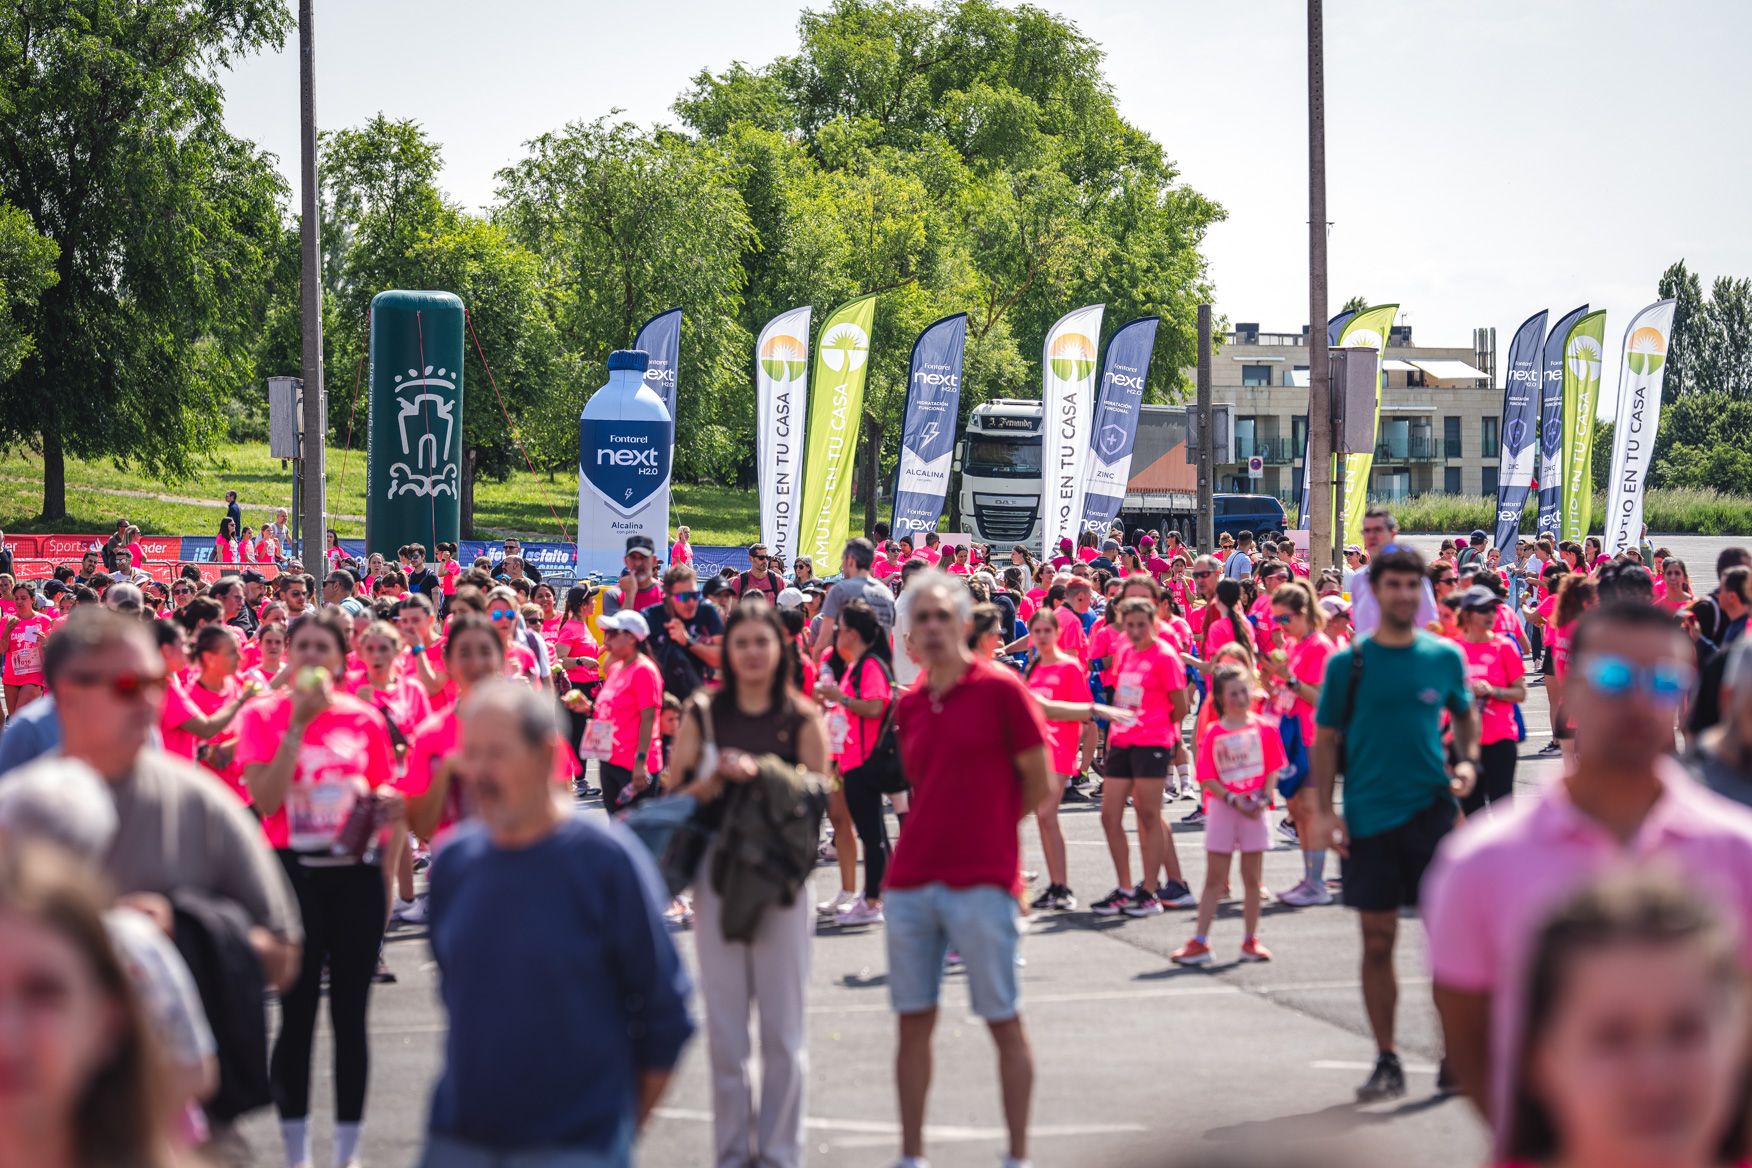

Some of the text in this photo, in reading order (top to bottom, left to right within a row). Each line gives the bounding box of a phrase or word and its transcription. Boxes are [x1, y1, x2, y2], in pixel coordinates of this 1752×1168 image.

[914, 372, 958, 387] next
[1104, 371, 1144, 390] next
[1508, 369, 1538, 381] next
[1543, 369, 1563, 381] ne
[1061, 392, 1077, 440] CASA
[610, 434, 648, 444] Fontarel
[597, 447, 659, 466] next
[1061, 446, 1075, 470] TU
[638, 467, 659, 475] H2.0
[905, 468, 945, 479] ALCALINA
[1570, 391, 1590, 541] UTIO EN TU CASA
[1616, 386, 1646, 552] MUTIO EN TU CASA
[775, 392, 790, 560] MUTIO EN TU CASA
[815, 383, 848, 568] AMUTIO EN TU CASA
[1096, 470, 1115, 480] ZINC
[1060, 476, 1074, 499] EN
[1497, 509, 1522, 522] ex
[611, 521, 644, 530] Alcalina
[896, 516, 937, 532] next
[49, 539, 88, 554] Sports
[525, 548, 570, 564] asfalto
